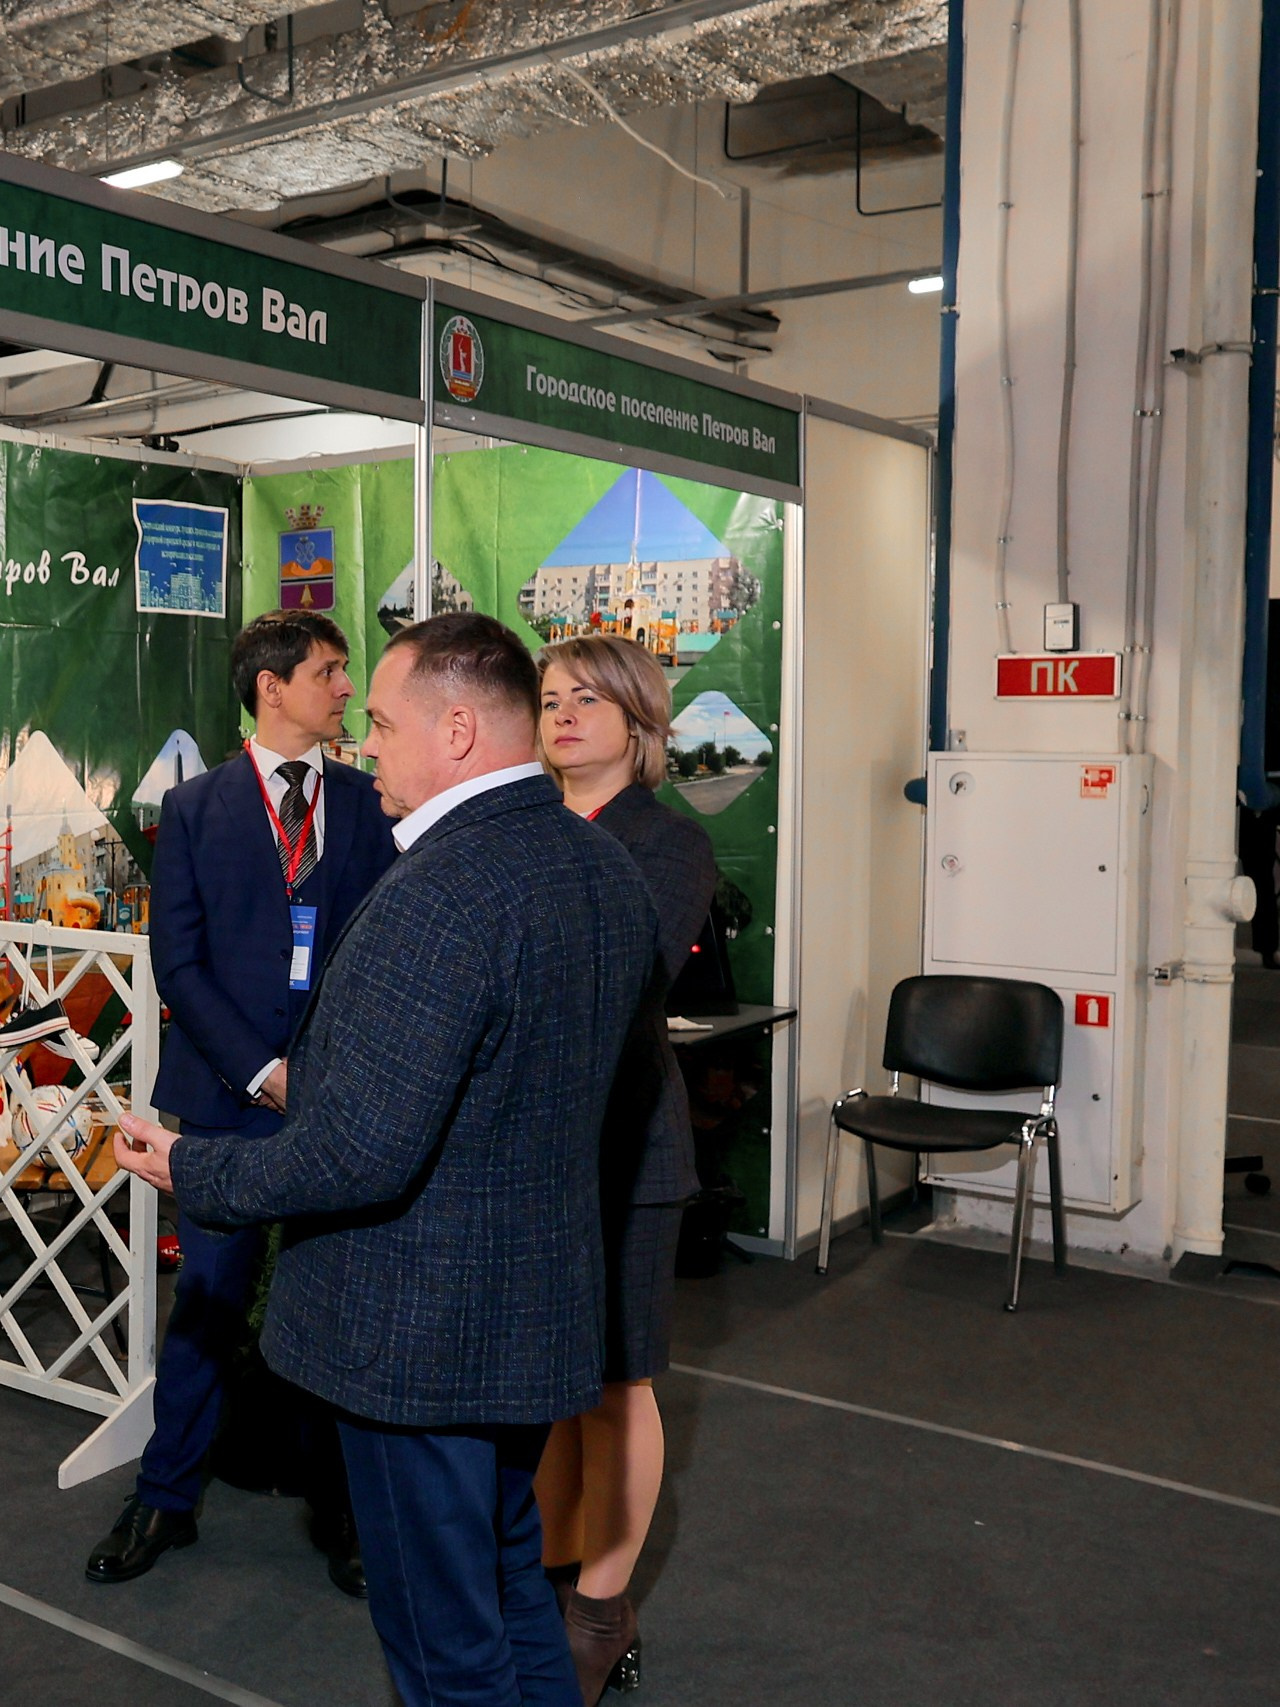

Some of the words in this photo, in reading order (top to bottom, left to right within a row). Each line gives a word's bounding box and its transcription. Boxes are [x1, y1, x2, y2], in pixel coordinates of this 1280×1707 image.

[101, 243, 249, 325] Петров
[261, 286, 327, 345] Вал
[526, 364, 617, 412] Городское
[621, 396, 699, 434] поселение
[702, 413, 750, 447] Петров
[752, 427, 776, 454] Вал
[61, 549, 120, 588] Вал
[1030, 660, 1080, 694] ПК
